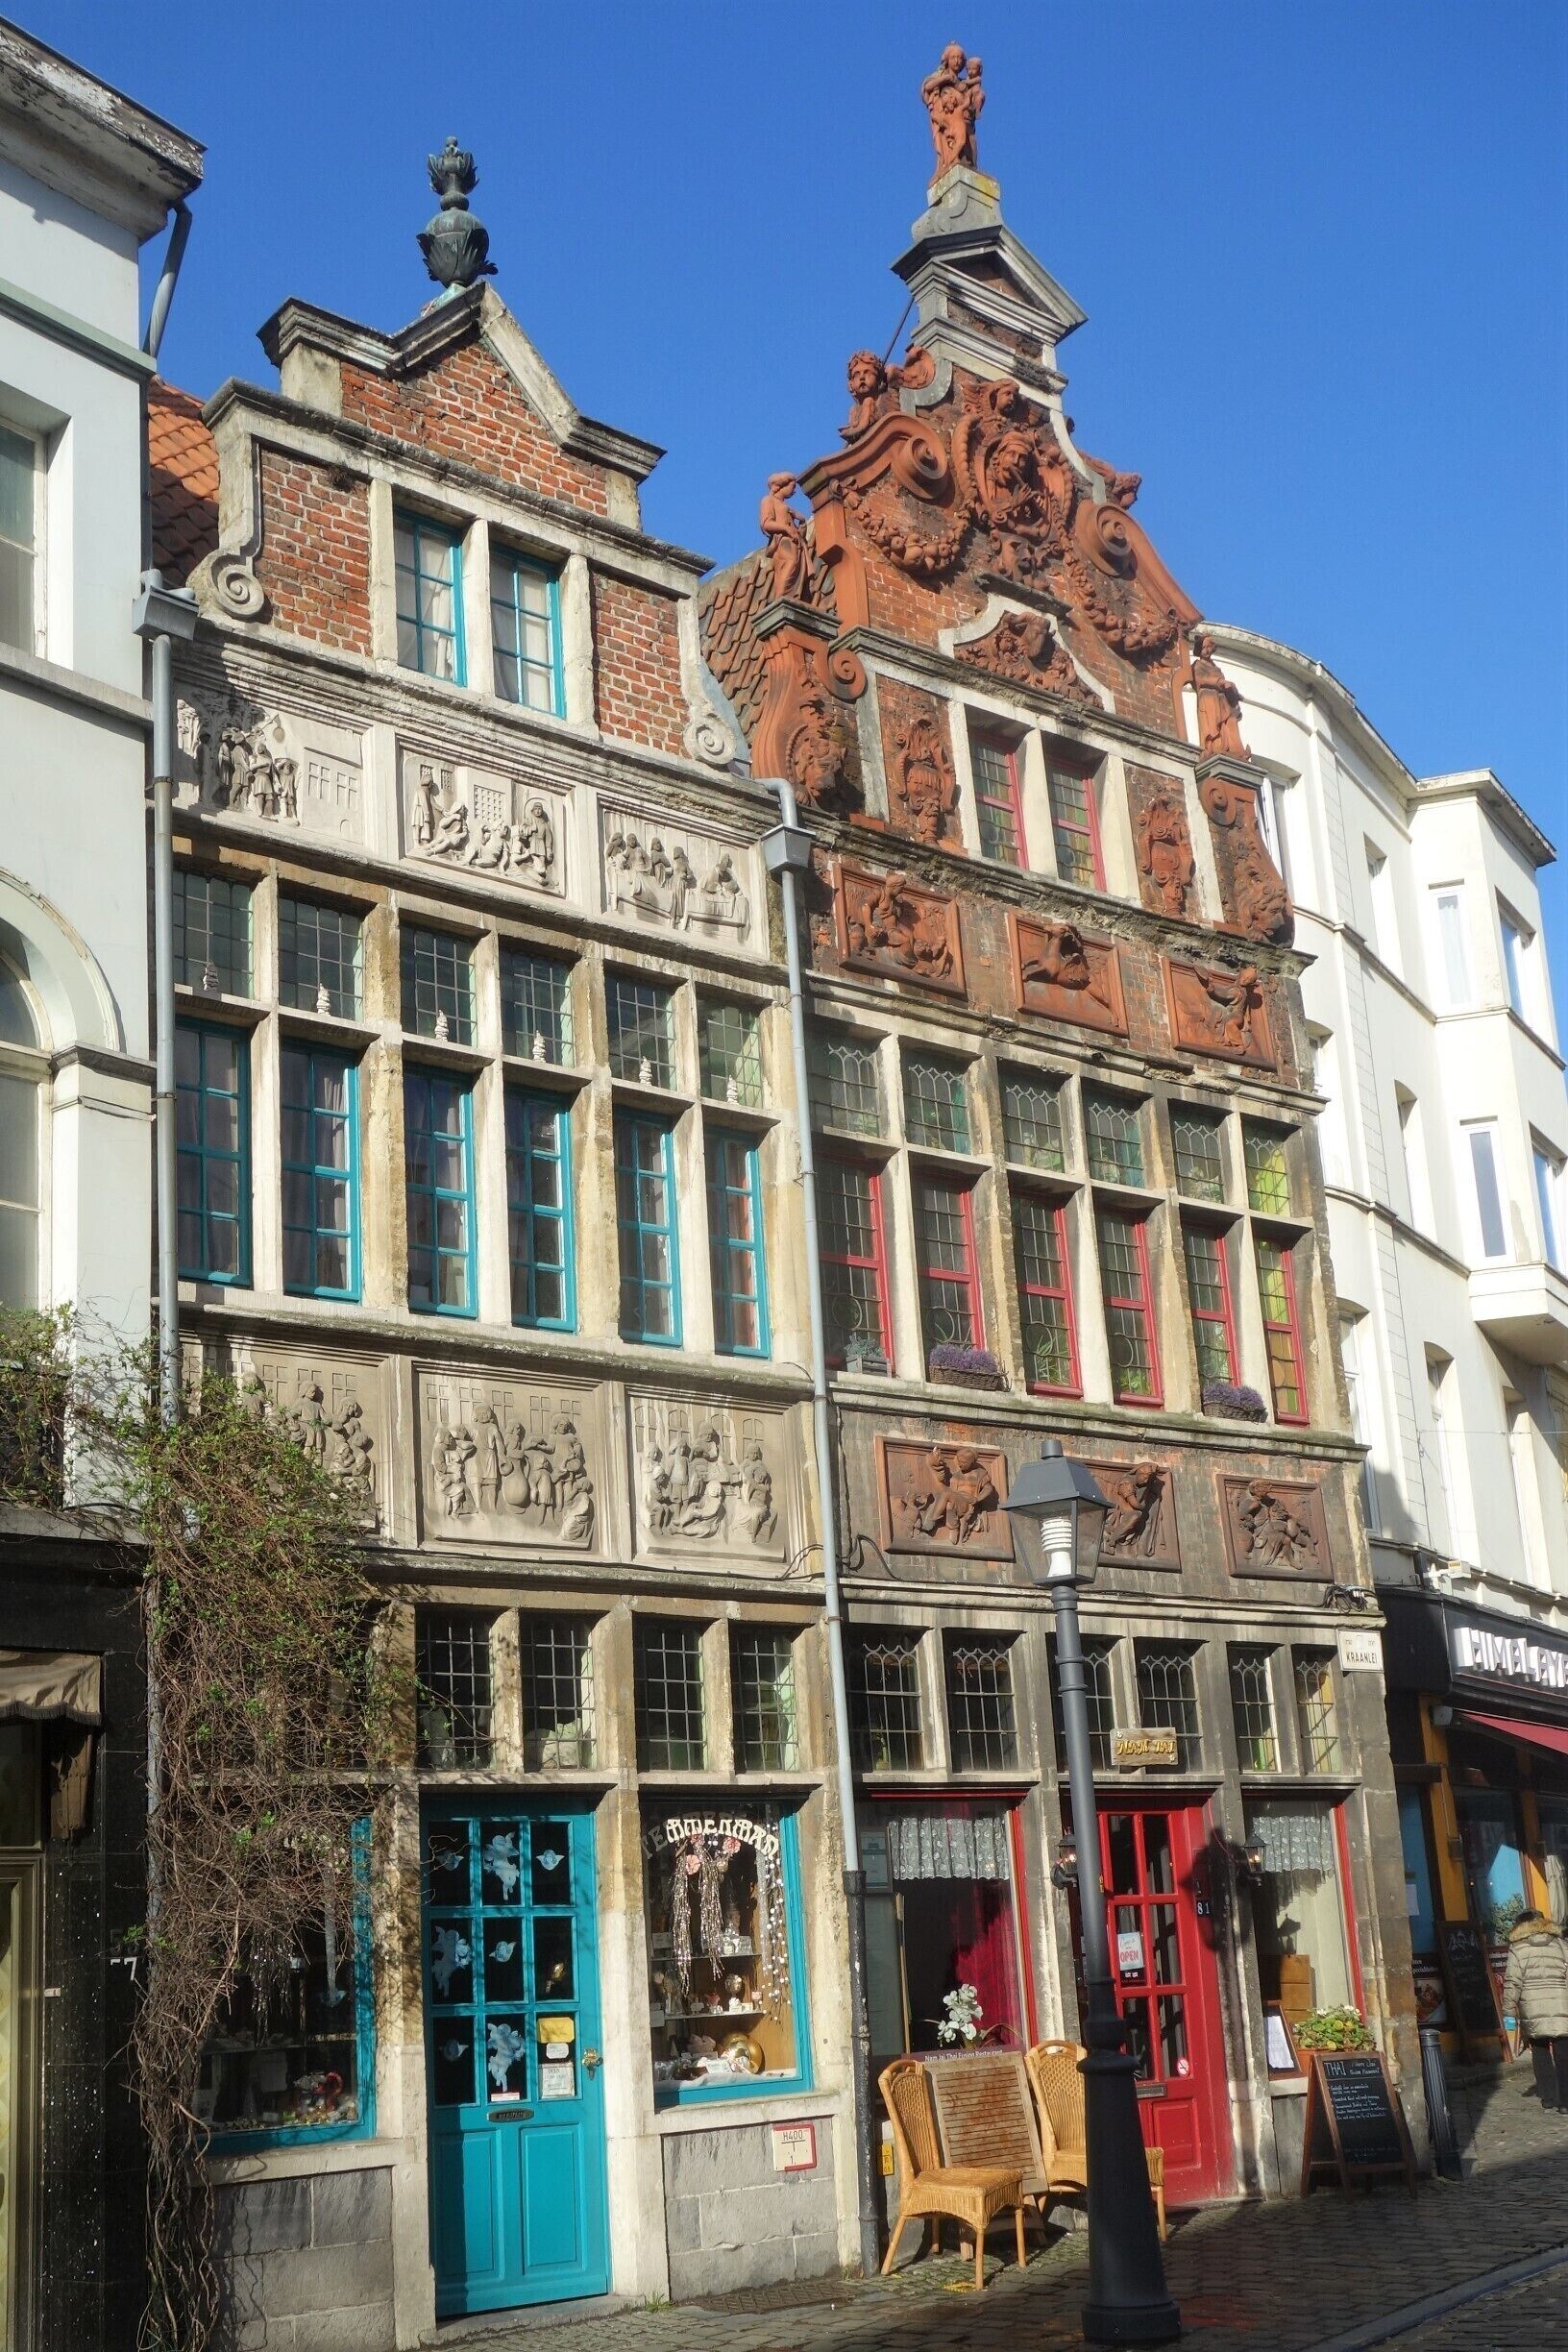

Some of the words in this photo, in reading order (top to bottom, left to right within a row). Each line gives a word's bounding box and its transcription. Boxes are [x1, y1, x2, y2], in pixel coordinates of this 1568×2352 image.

[1345, 1652, 1378, 1664] KRAANLEI
[1197, 1902, 1210, 1915] 81
[1120, 1949, 1139, 1962] OPEN
[1324, 2061, 1347, 2075] THAI
[783, 2130, 803, 2141] H400
